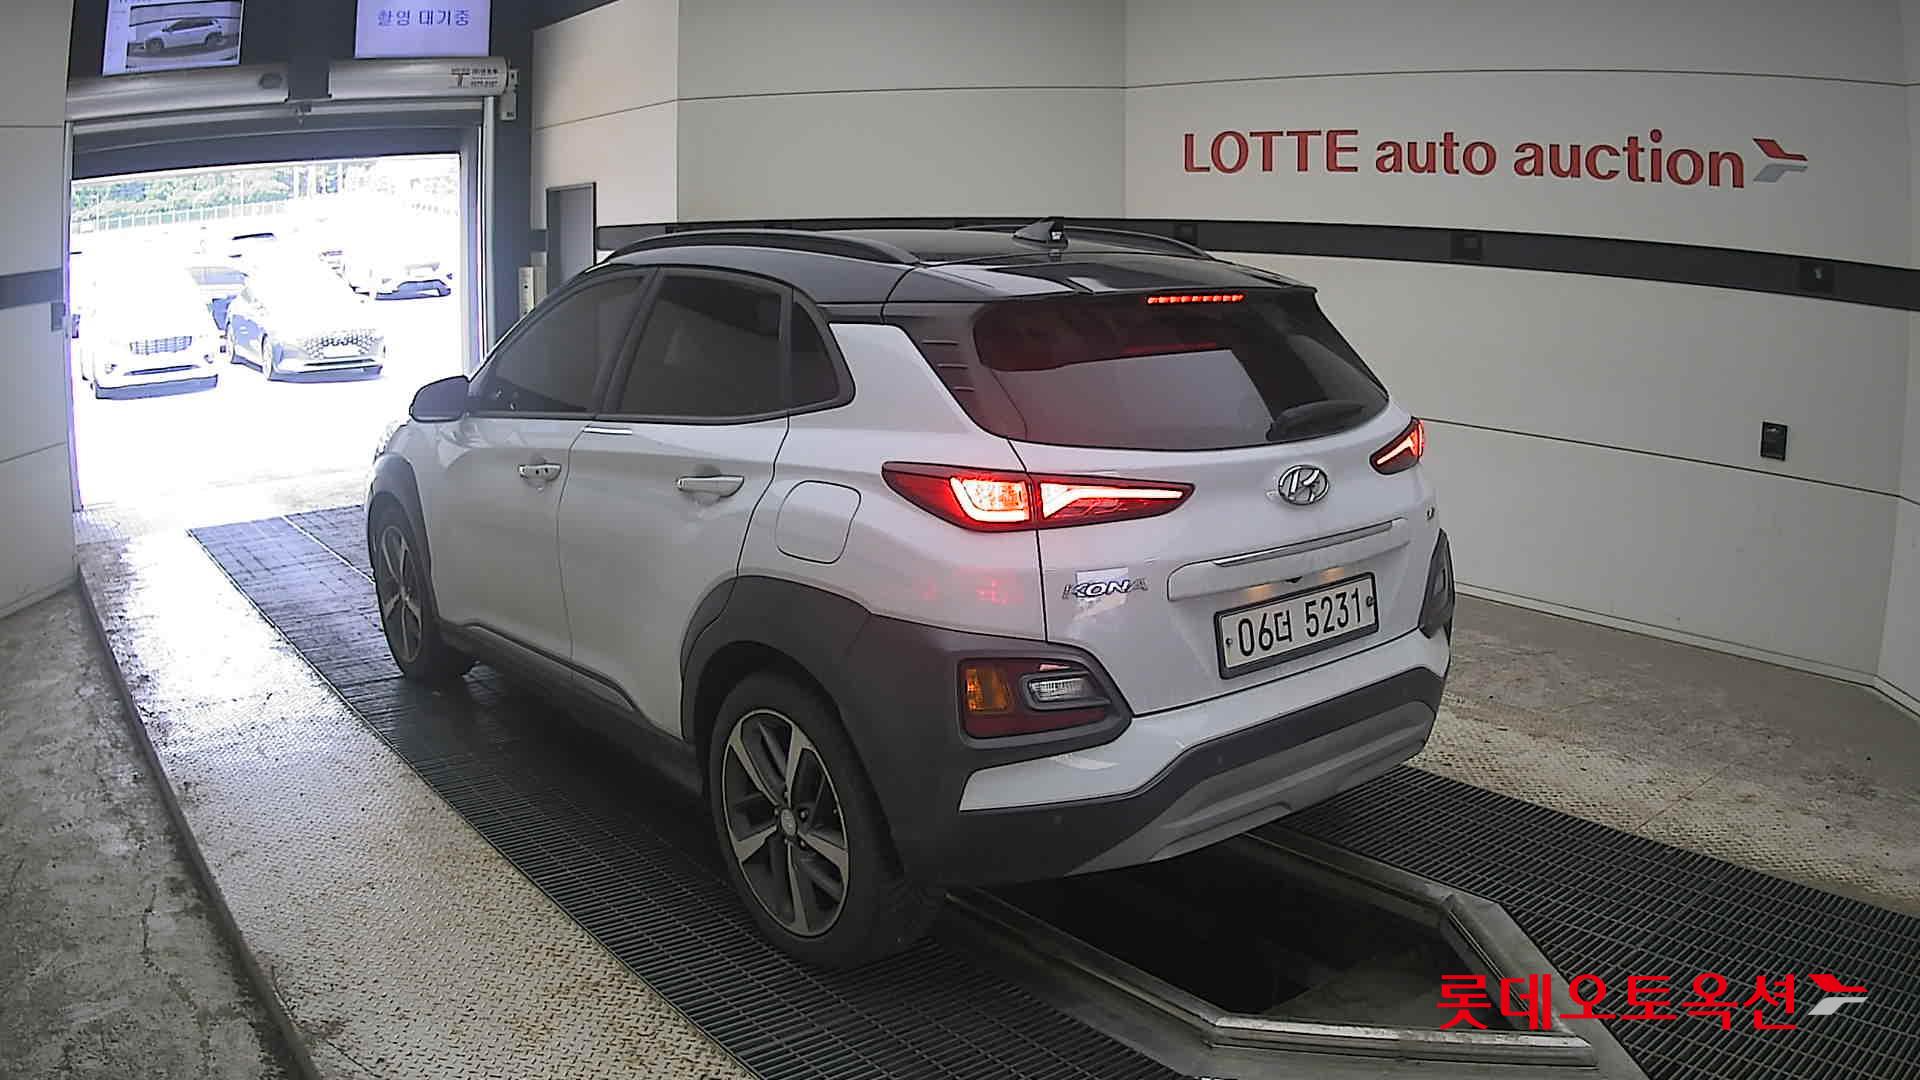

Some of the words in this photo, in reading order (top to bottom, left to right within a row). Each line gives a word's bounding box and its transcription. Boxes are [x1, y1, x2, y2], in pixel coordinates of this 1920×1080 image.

[419, 9, 470, 26] 대기중
[1184, 129, 1359, 174] LOTTE
[1376, 131, 1497, 176] auto
[1513, 129, 1745, 188] auction
[1062, 579, 1148, 600] KONA
[1238, 610, 1292, 656] 06더
[1304, 587, 1361, 637] 5231
